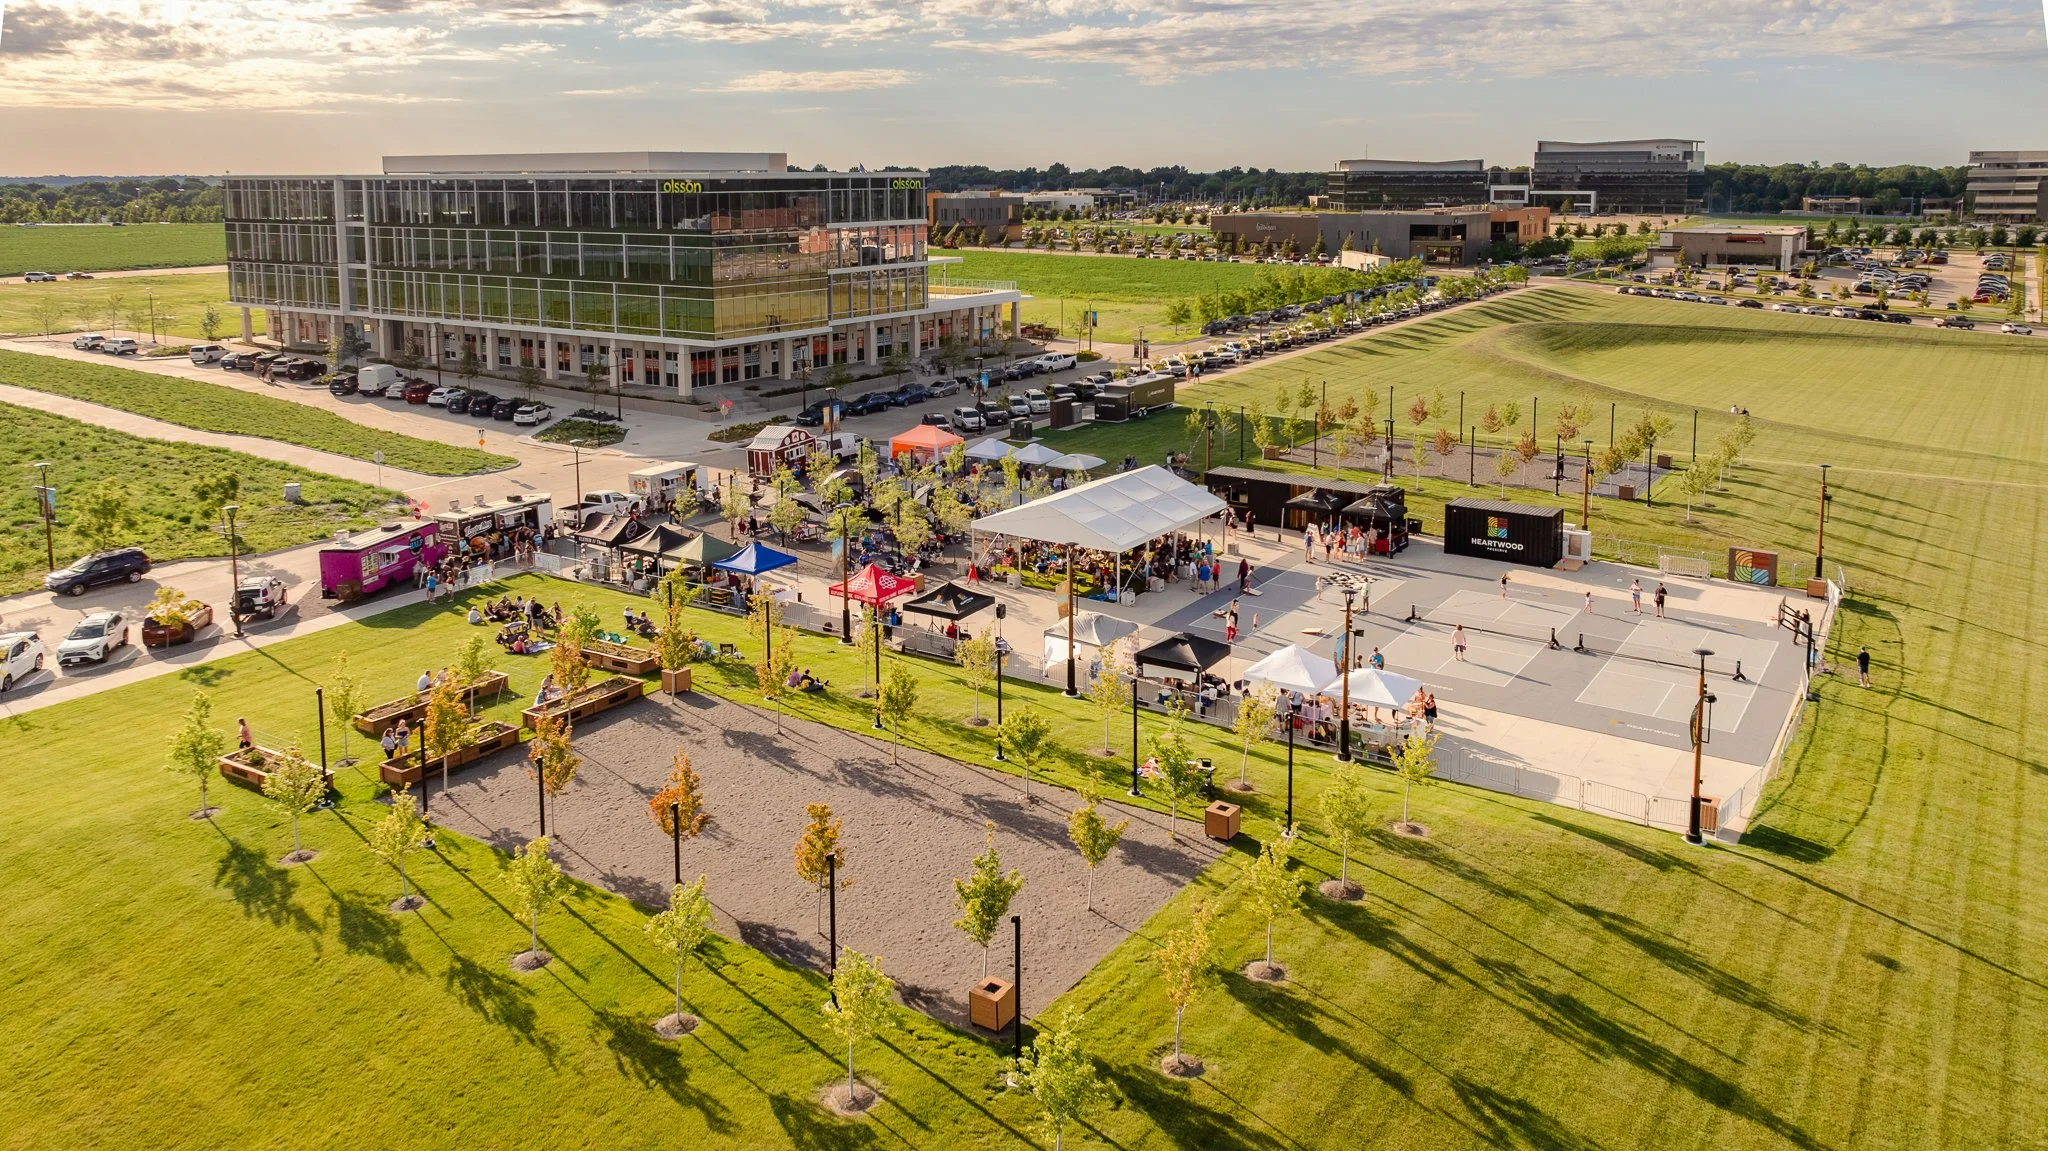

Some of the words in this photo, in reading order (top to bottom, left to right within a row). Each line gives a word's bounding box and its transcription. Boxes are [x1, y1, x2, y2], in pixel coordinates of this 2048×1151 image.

[663, 179, 702, 193] olsson
[892, 178, 921, 189] olsson
[1471, 538, 1524, 551] HEARTWOOD
[1626, 724, 1680, 737] HEARTWOOD
